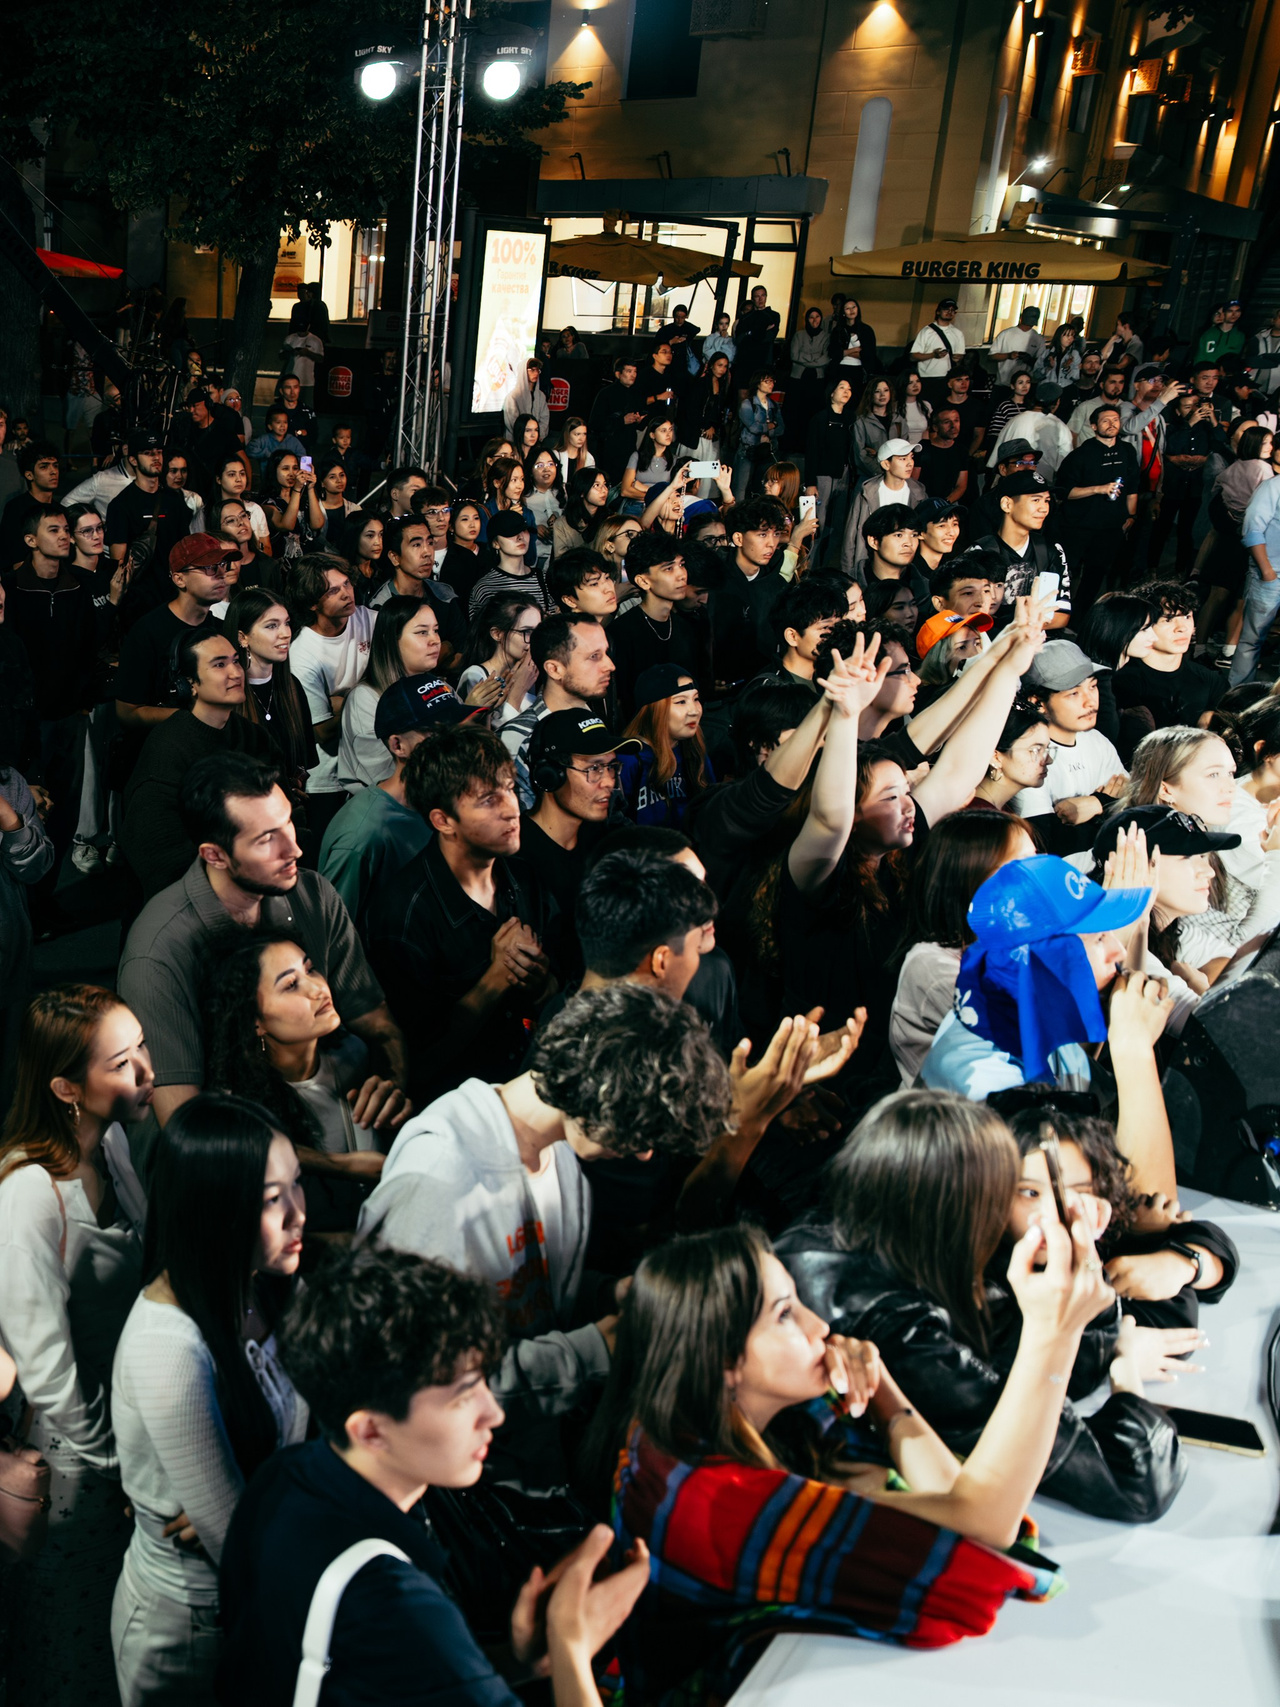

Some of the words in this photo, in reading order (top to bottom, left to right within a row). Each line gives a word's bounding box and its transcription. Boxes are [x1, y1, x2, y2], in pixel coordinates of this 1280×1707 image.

[355, 46, 374, 57] LIGHT
[377, 45, 393, 54] SKY
[496, 46, 518, 55] LIGHT
[491, 238, 537, 266] 100%
[901, 260, 982, 278] BURGER
[986, 261, 1041, 279] KING
[491, 283, 529, 294] качества
[417, 680, 445, 694] ORAC
